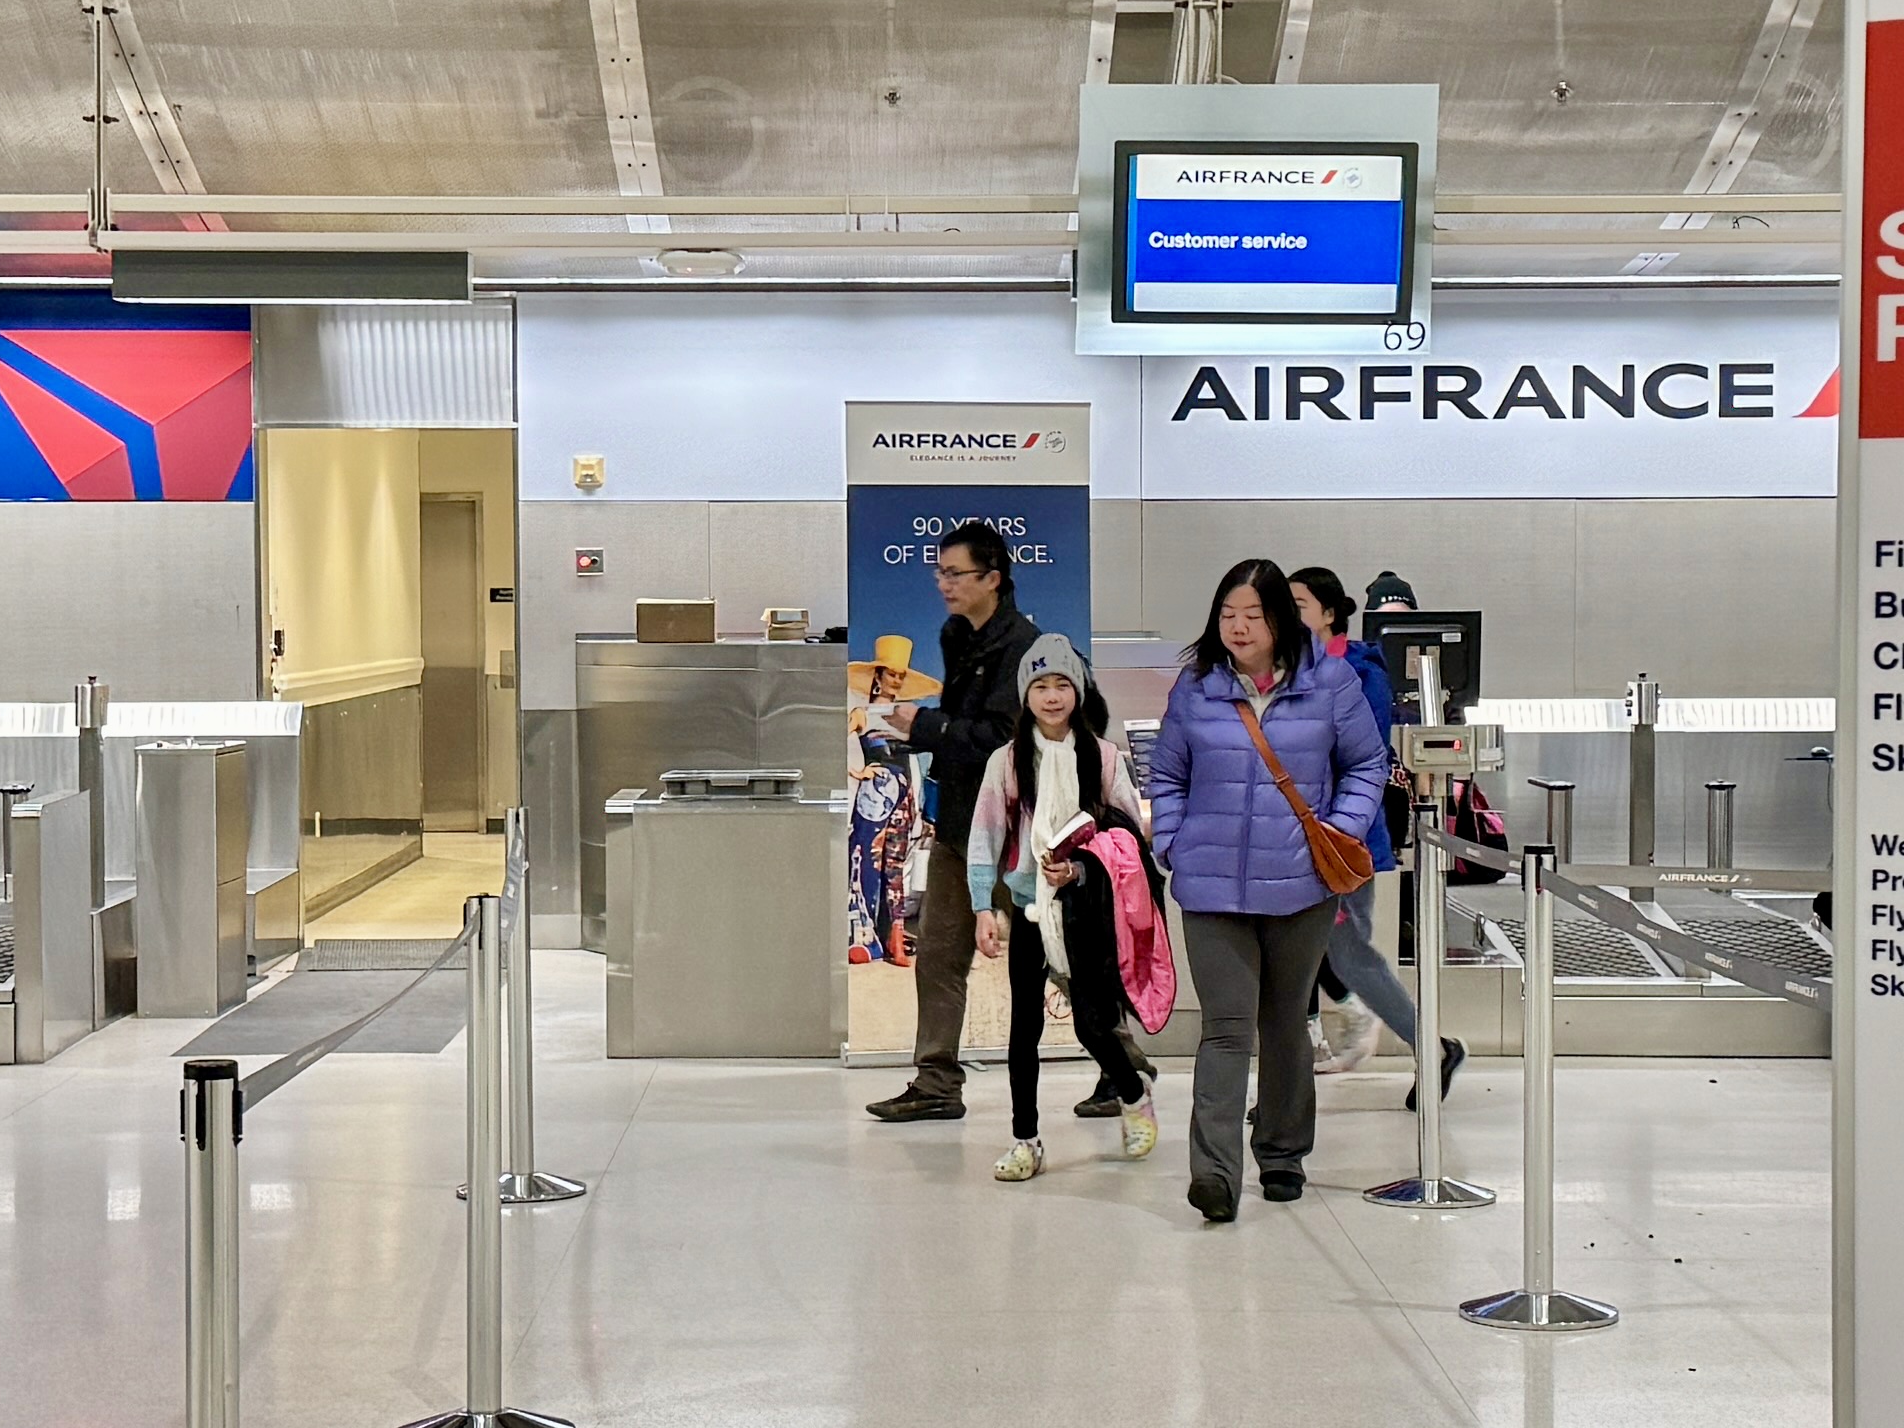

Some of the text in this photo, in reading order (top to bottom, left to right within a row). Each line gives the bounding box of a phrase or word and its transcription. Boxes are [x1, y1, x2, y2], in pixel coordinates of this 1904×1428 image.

[1176, 170, 1315, 184] AIRFRANCE
[1148, 231, 1308, 250] Customer service
[1383, 320, 1426, 351] 69
[1170, 361, 1775, 422] AIRFRANCE
[872, 433, 1017, 448] AIRFRANCE
[913, 516, 1027, 537] 90 YARS
[883, 544, 916, 564] OF
[1658, 873, 1729, 883] AIRFRANCE
